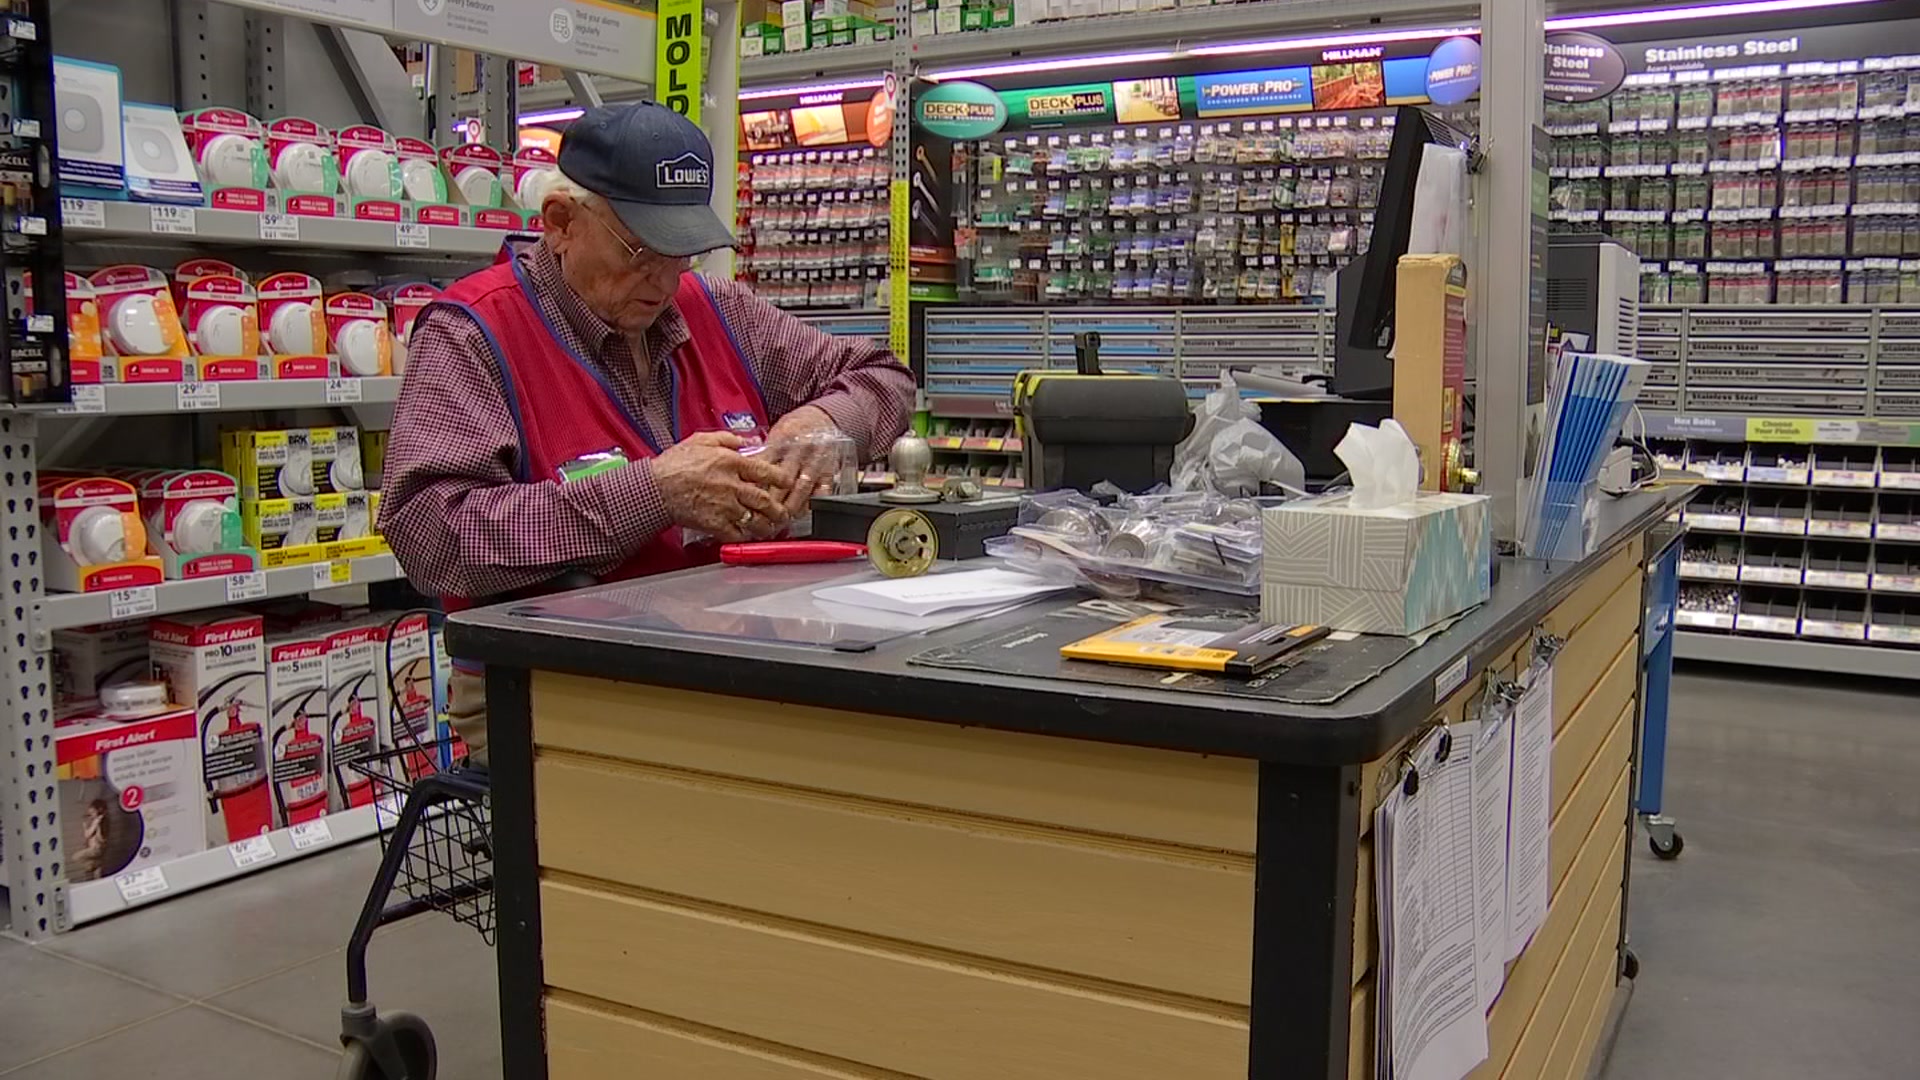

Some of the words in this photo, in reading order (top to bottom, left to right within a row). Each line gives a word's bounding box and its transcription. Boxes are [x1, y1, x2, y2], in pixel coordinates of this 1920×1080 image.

[1322, 47, 1381, 60] HILLMAN
[1645, 45, 1738, 63] Stainless
[1743, 37, 1798, 55] Steel
[1553, 58, 1589, 70] Steel
[1211, 83, 1258, 96] POWER
[1264, 80, 1292, 93] PRO
[1030, 97, 1070, 110] DECK
[1076, 94, 1104, 106] PLUS
[925, 103, 964, 114] DECK
[969, 105, 995, 115] PLUS
[288, 435, 308, 445] BRK
[337, 430, 355, 440] BRK
[293, 502, 312, 511] BRK
[347, 496, 365, 506] BRK
[204, 631, 228, 644] First
[230, 626, 254, 639] Alert
[332, 636, 350, 648] First
[351, 632, 368, 644] Alert
[220, 645, 232, 657] 10
[278, 650, 298, 661] First
[299, 645, 321, 657] Alert
[345, 649, 351, 659] 5
[292, 661, 299, 672] 5
[96, 739, 124, 751] First
[125, 731, 155, 744] Alert
[126, 787, 140, 807] 2
